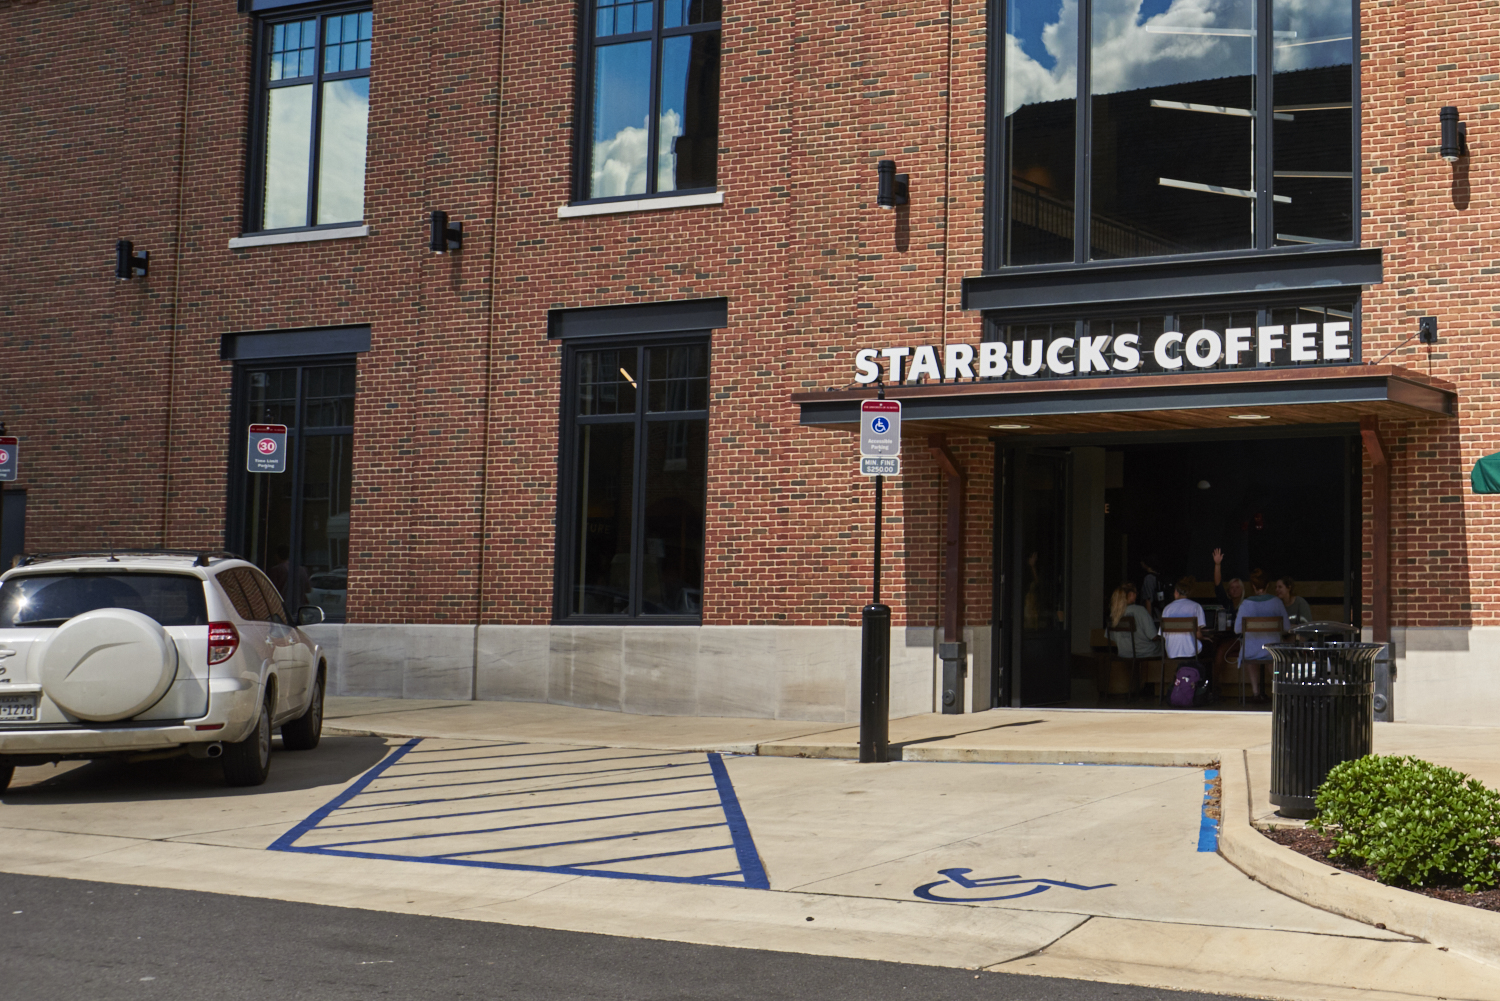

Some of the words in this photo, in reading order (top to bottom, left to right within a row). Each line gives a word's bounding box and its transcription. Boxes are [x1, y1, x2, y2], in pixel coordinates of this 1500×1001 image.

[855, 333, 1140, 384] STARBUCKS
[1154, 321, 1350, 369] COFFEE
[260, 442, 275, 451] 30
